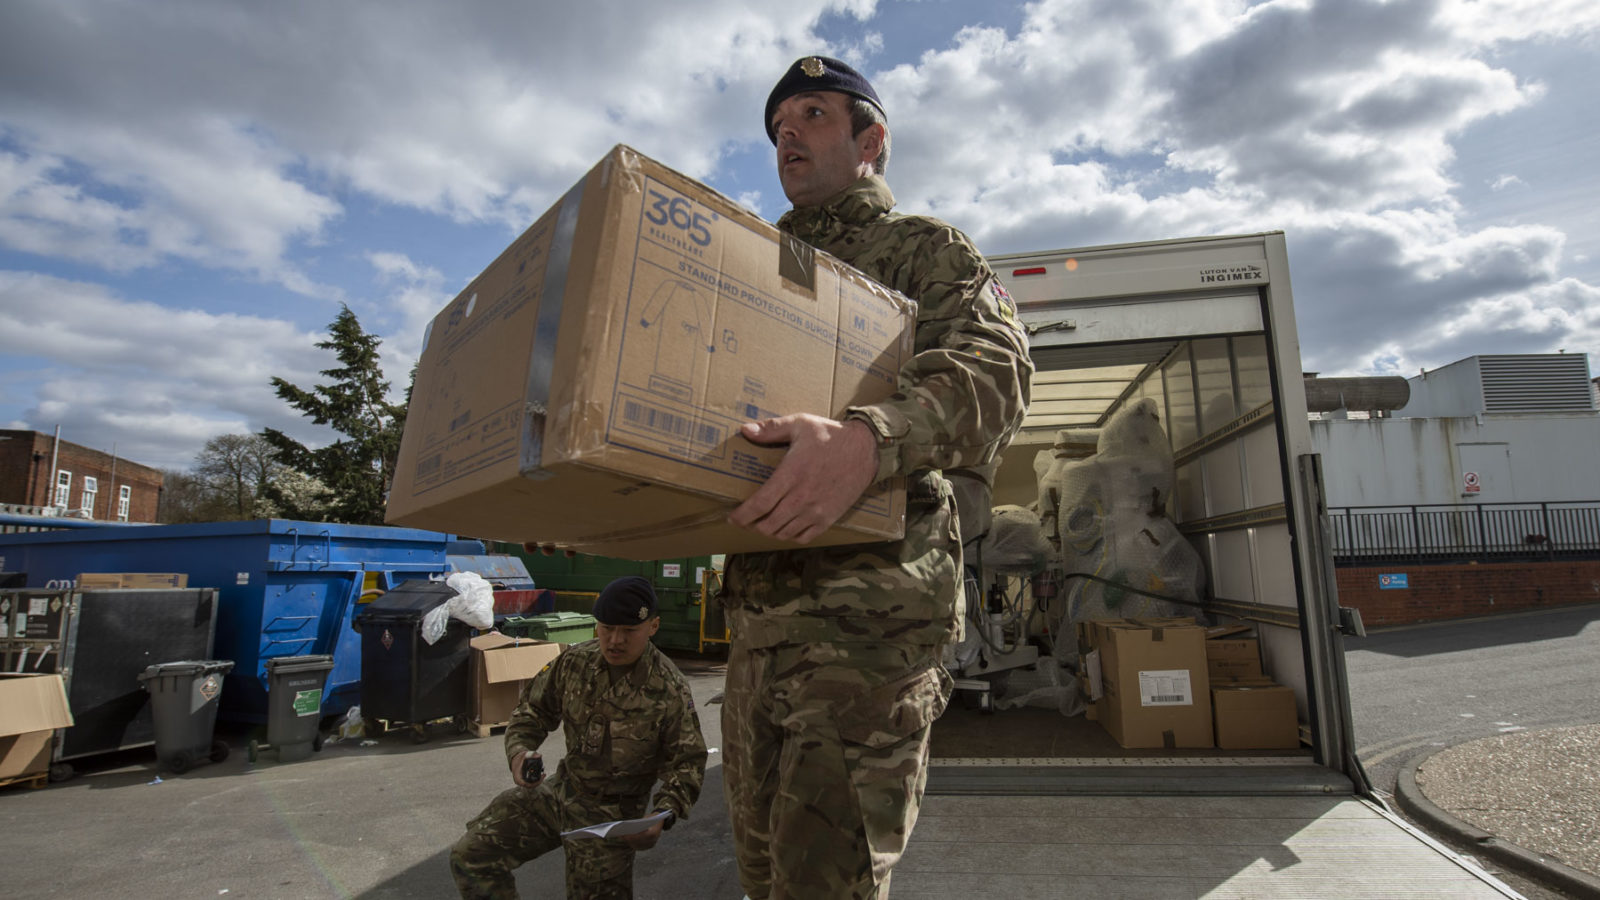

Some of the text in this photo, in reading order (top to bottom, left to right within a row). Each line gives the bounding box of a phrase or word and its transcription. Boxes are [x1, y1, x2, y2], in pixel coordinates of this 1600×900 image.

[645, 188, 712, 247] 365
[678, 261, 739, 297] STANDARD
[741, 289, 803, 326] PROTECTION
[1200, 271, 1262, 283] INGIMEX
[854, 314, 866, 331] M
